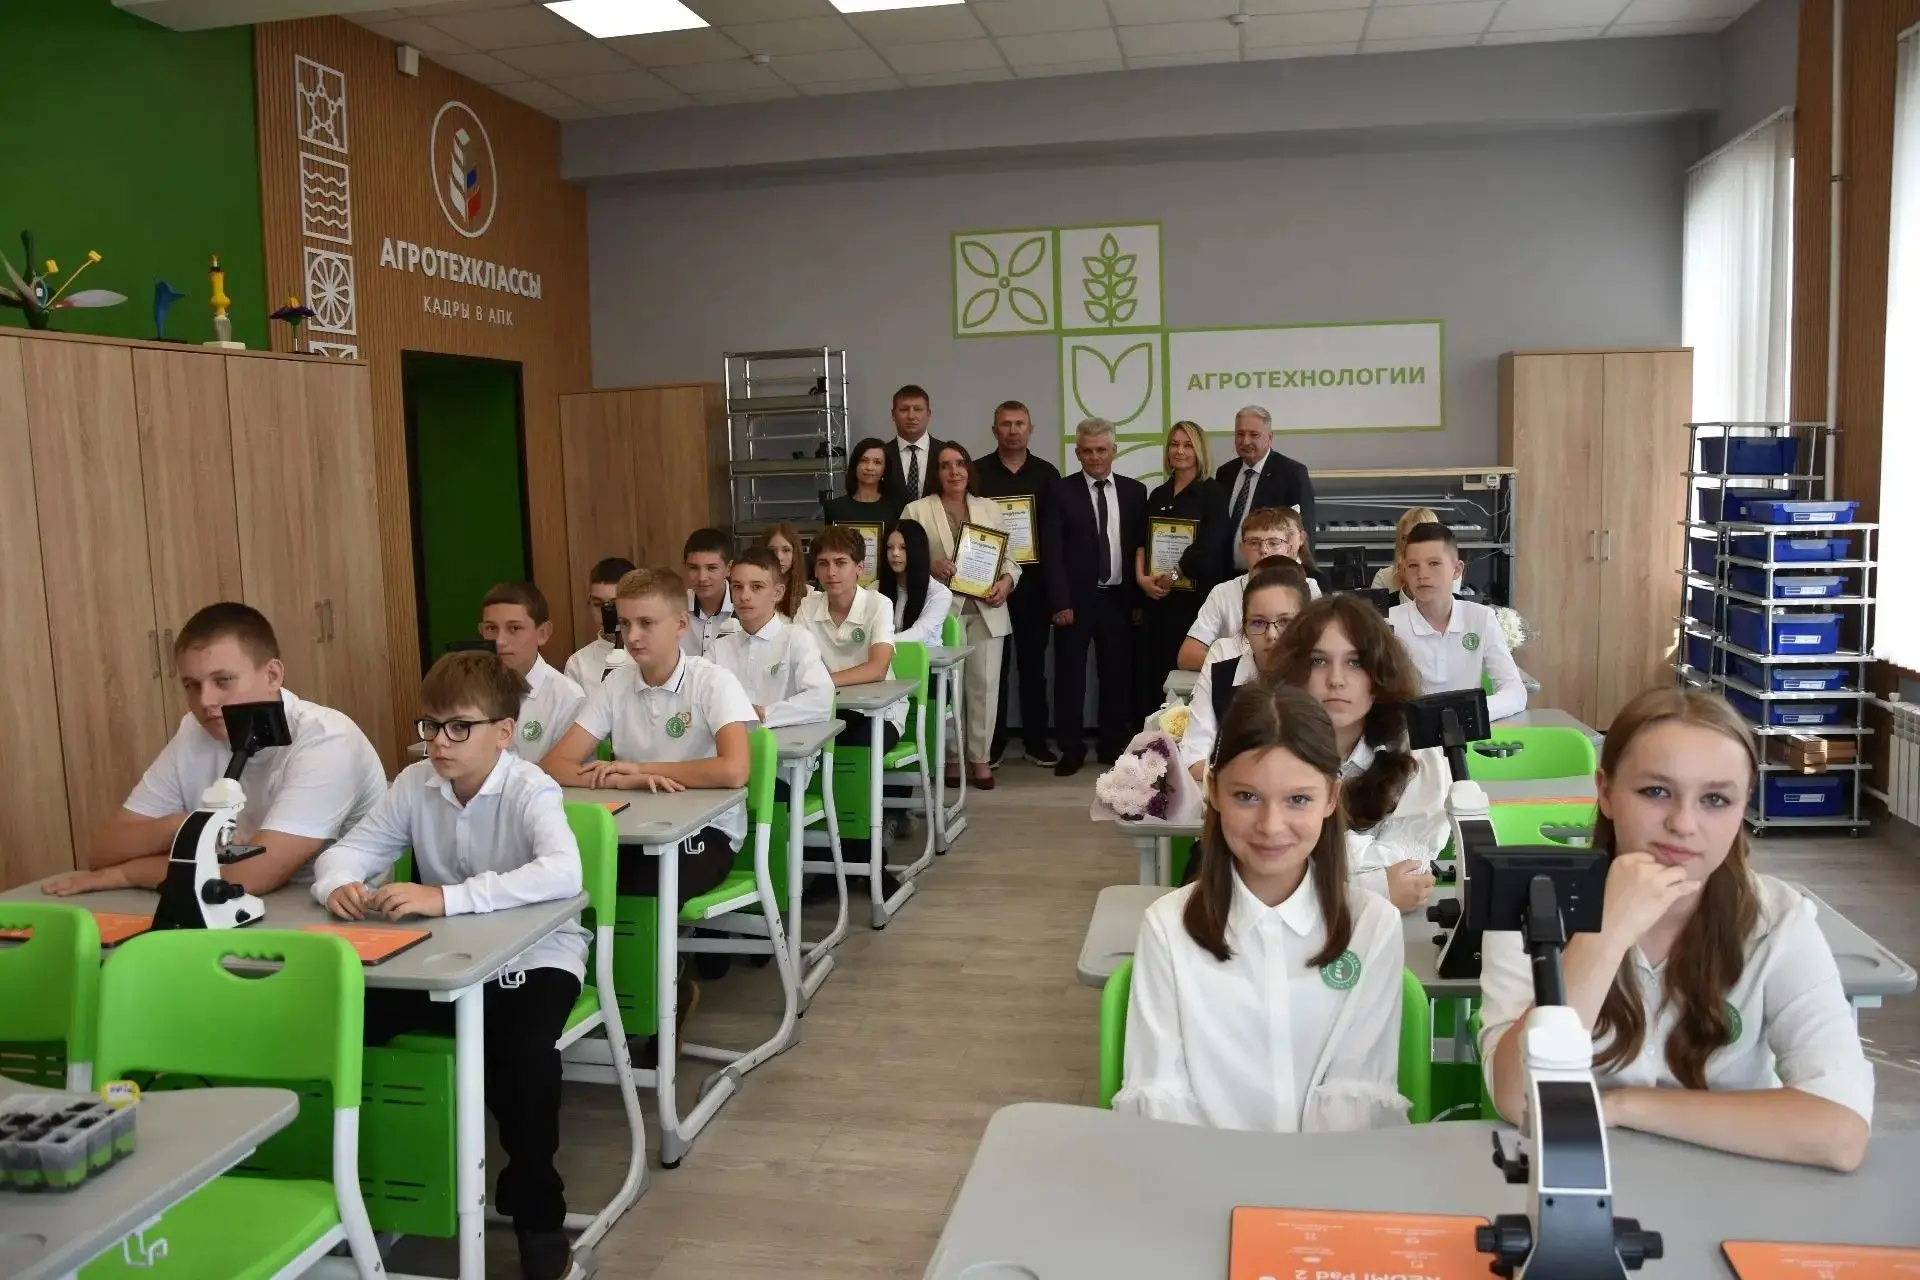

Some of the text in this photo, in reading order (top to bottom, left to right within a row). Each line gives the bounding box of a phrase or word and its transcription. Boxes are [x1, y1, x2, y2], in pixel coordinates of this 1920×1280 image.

[379, 237, 542, 299] АГРОТЕХКЛАССЫ
[423, 295, 513, 326] КАДРЫ В АПК
[1187, 366, 1426, 391] АГРОТЕХНОЛОГИИ
[1295, 1269, 1309, 1280] 2
[1315, 1270, 1356, 1280] Pad
